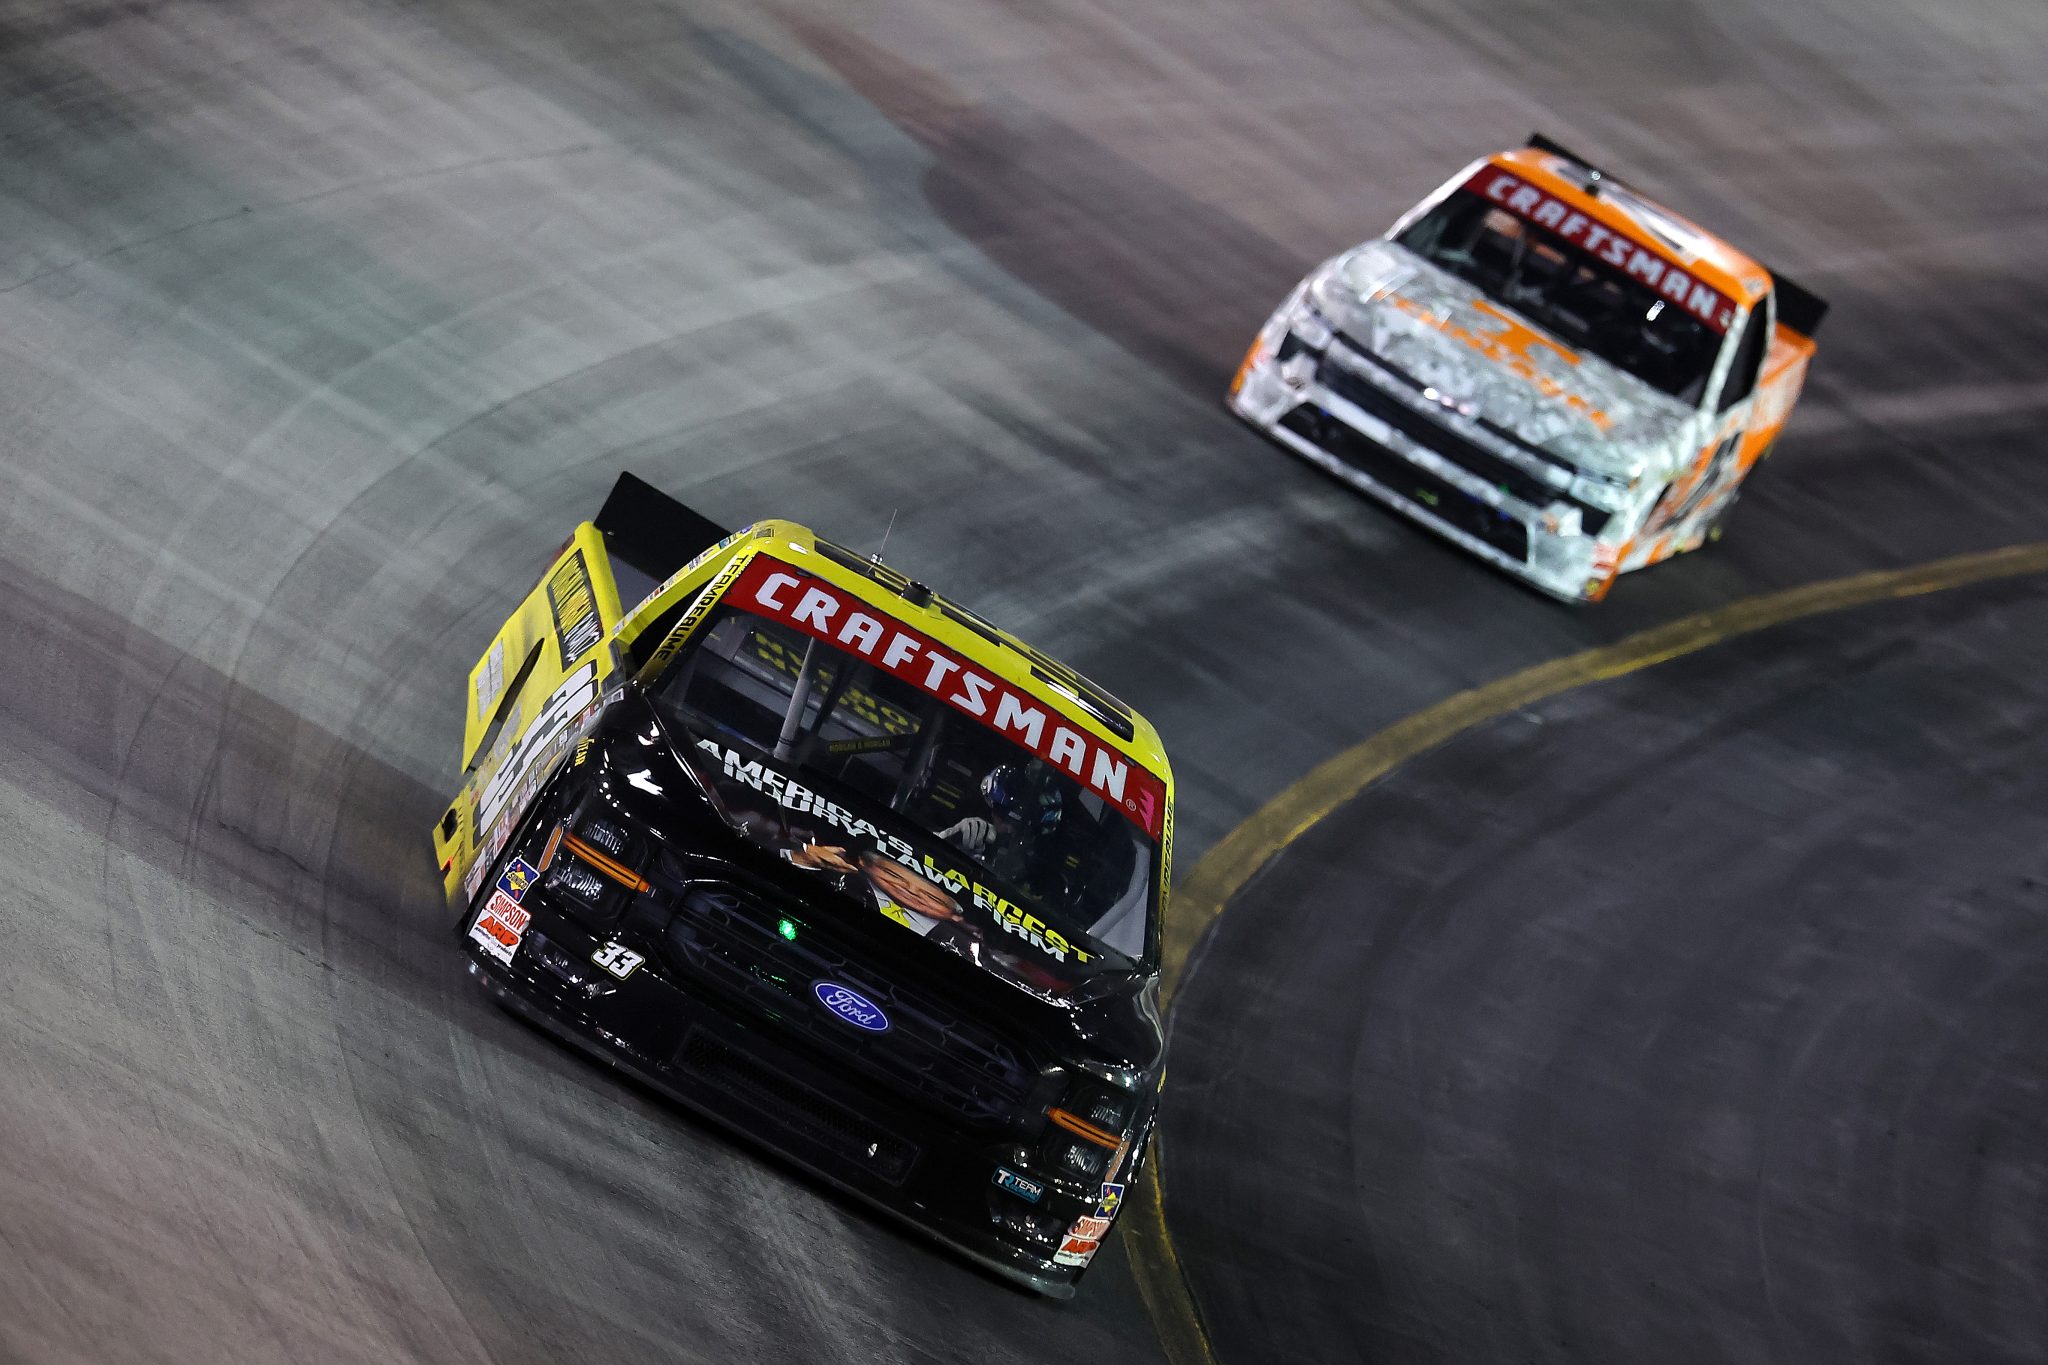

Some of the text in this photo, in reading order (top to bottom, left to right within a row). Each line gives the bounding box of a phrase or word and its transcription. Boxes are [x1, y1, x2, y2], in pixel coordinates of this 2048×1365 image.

[1487, 174, 1718, 321] CRAFTSMAN
[755, 572, 1128, 803] CRAFTSMAN
[697, 739, 1095, 964] AMERICA'S LARGEST
[724, 763, 1065, 963] INJURY LAW FIRM
[491, 894, 528, 930] SIMPSON
[478, 915, 519, 947] ARP
[592, 941, 643, 978] 33
[826, 990, 877, 1025] Ford
[1014, 1176, 1041, 1196] TEAM
